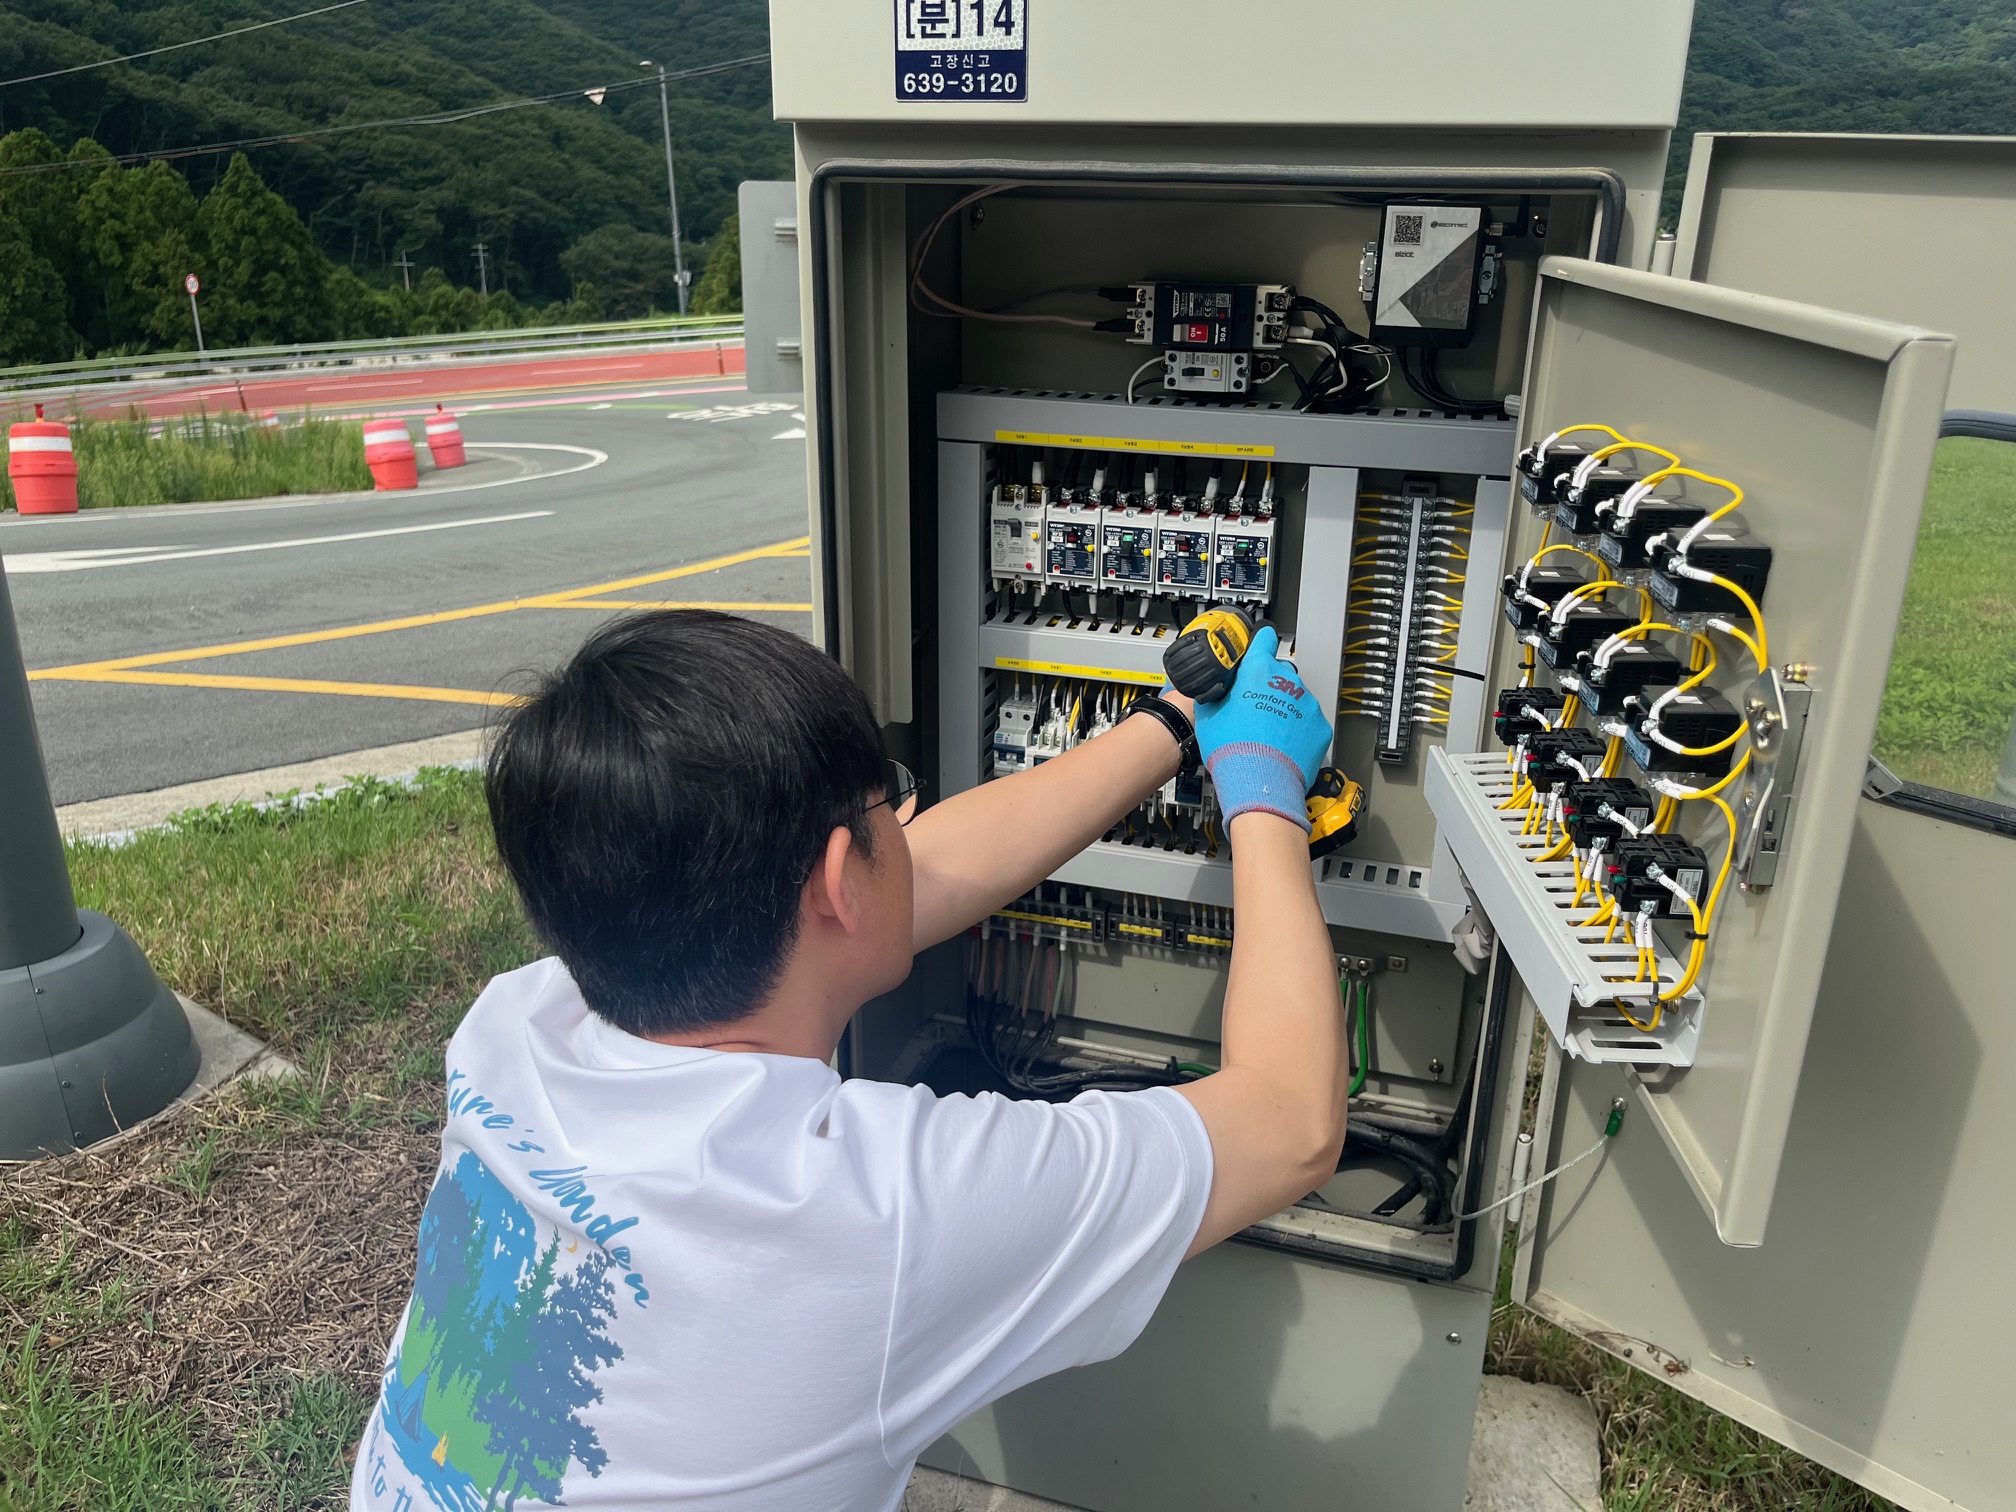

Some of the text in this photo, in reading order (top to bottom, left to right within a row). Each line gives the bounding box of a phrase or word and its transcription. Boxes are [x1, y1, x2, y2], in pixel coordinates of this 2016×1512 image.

[930, 54, 991, 69] 고장신고
[903, 73, 1018, 93] 639-3120
[1190, 327, 1196, 337] ON
[1219, 327, 1227, 342] 50A
[1267, 675, 1305, 701] 3M
[1242, 690, 1303, 719] Comfort Grip
[1255, 701, 1288, 719] Gloves
